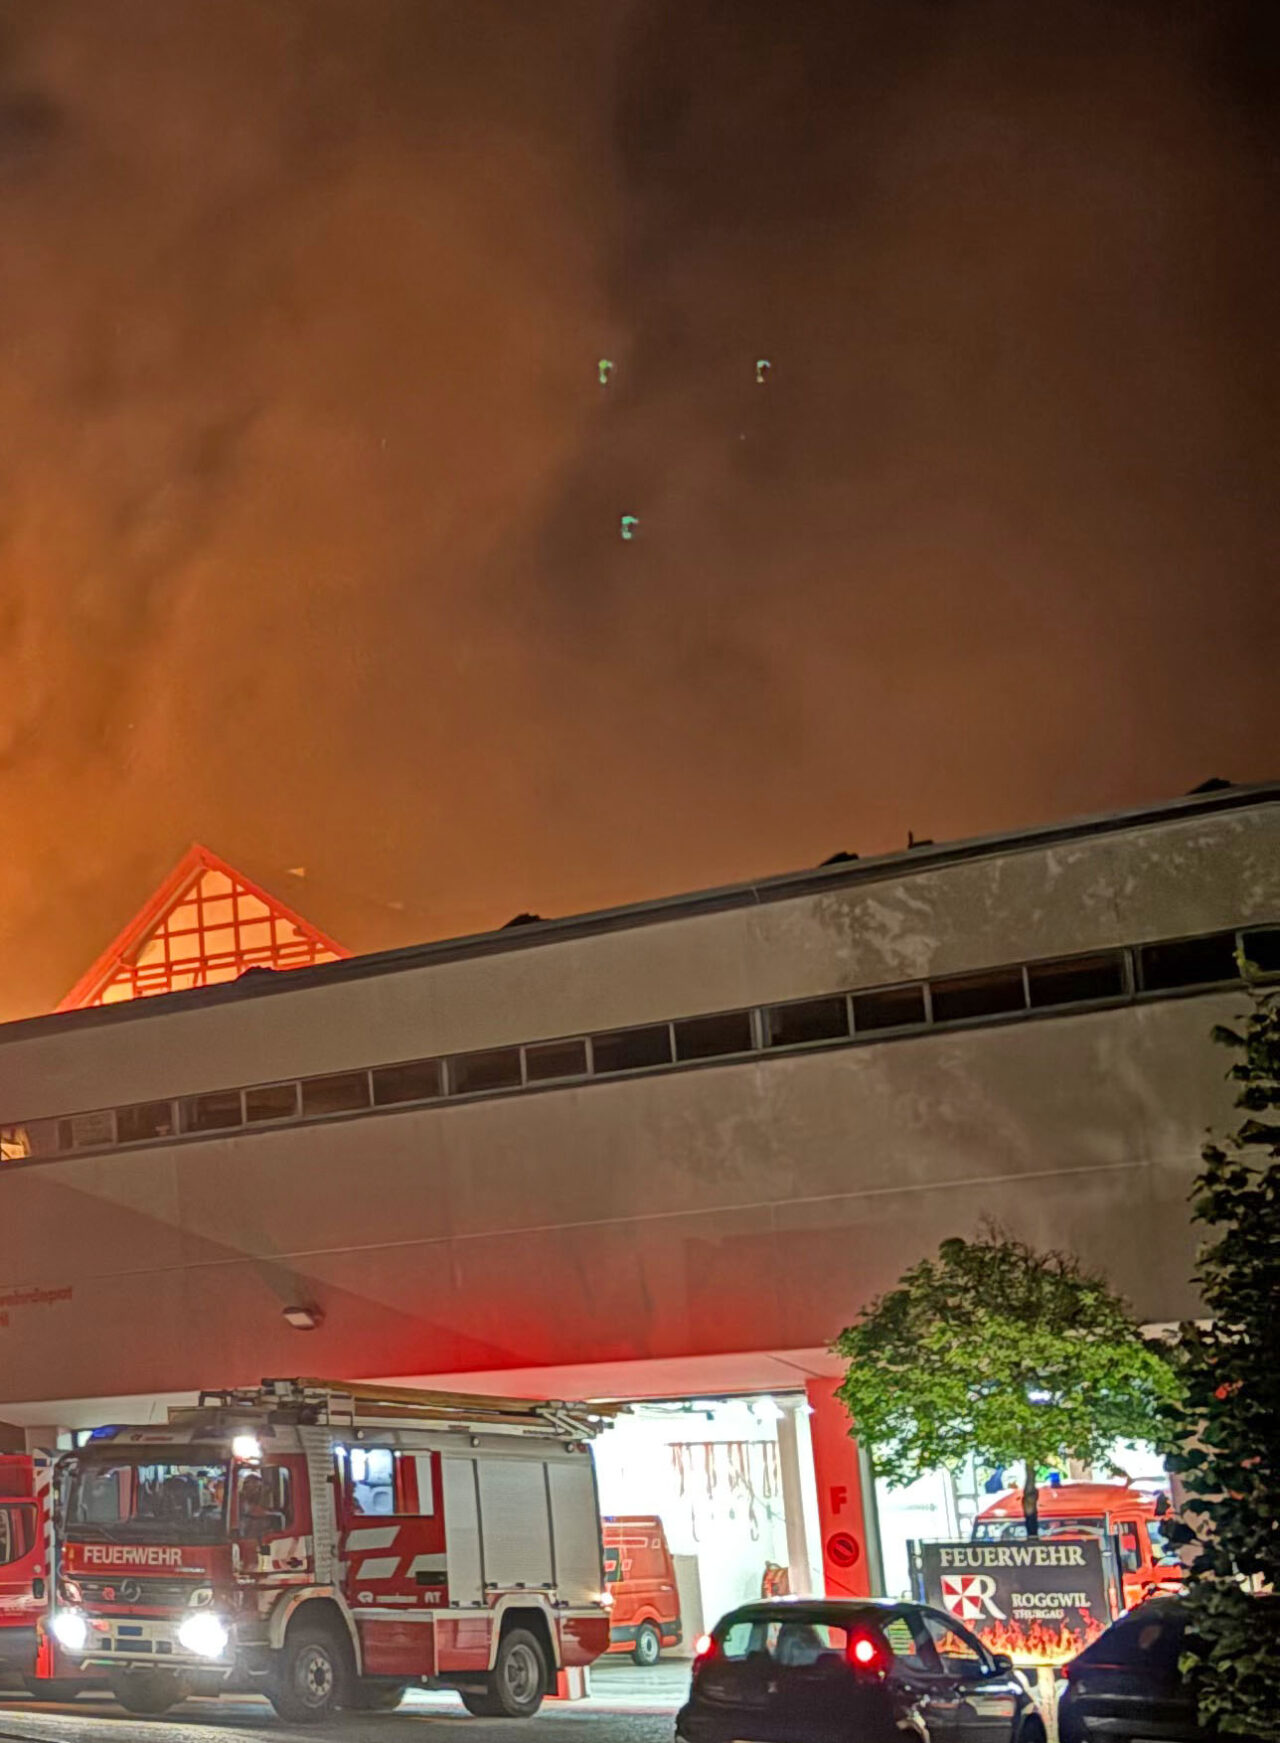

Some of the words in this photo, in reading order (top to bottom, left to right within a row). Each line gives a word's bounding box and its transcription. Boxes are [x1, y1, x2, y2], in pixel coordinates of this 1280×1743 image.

[830, 1486, 847, 1514] F
[83, 1546, 182, 1565] FEUERWEHR
[940, 1545, 1086, 1567] FEUERWEHR
[1011, 1592, 1092, 1608] ROGGWIL
[1012, 1609, 1064, 1620] THURGAU
